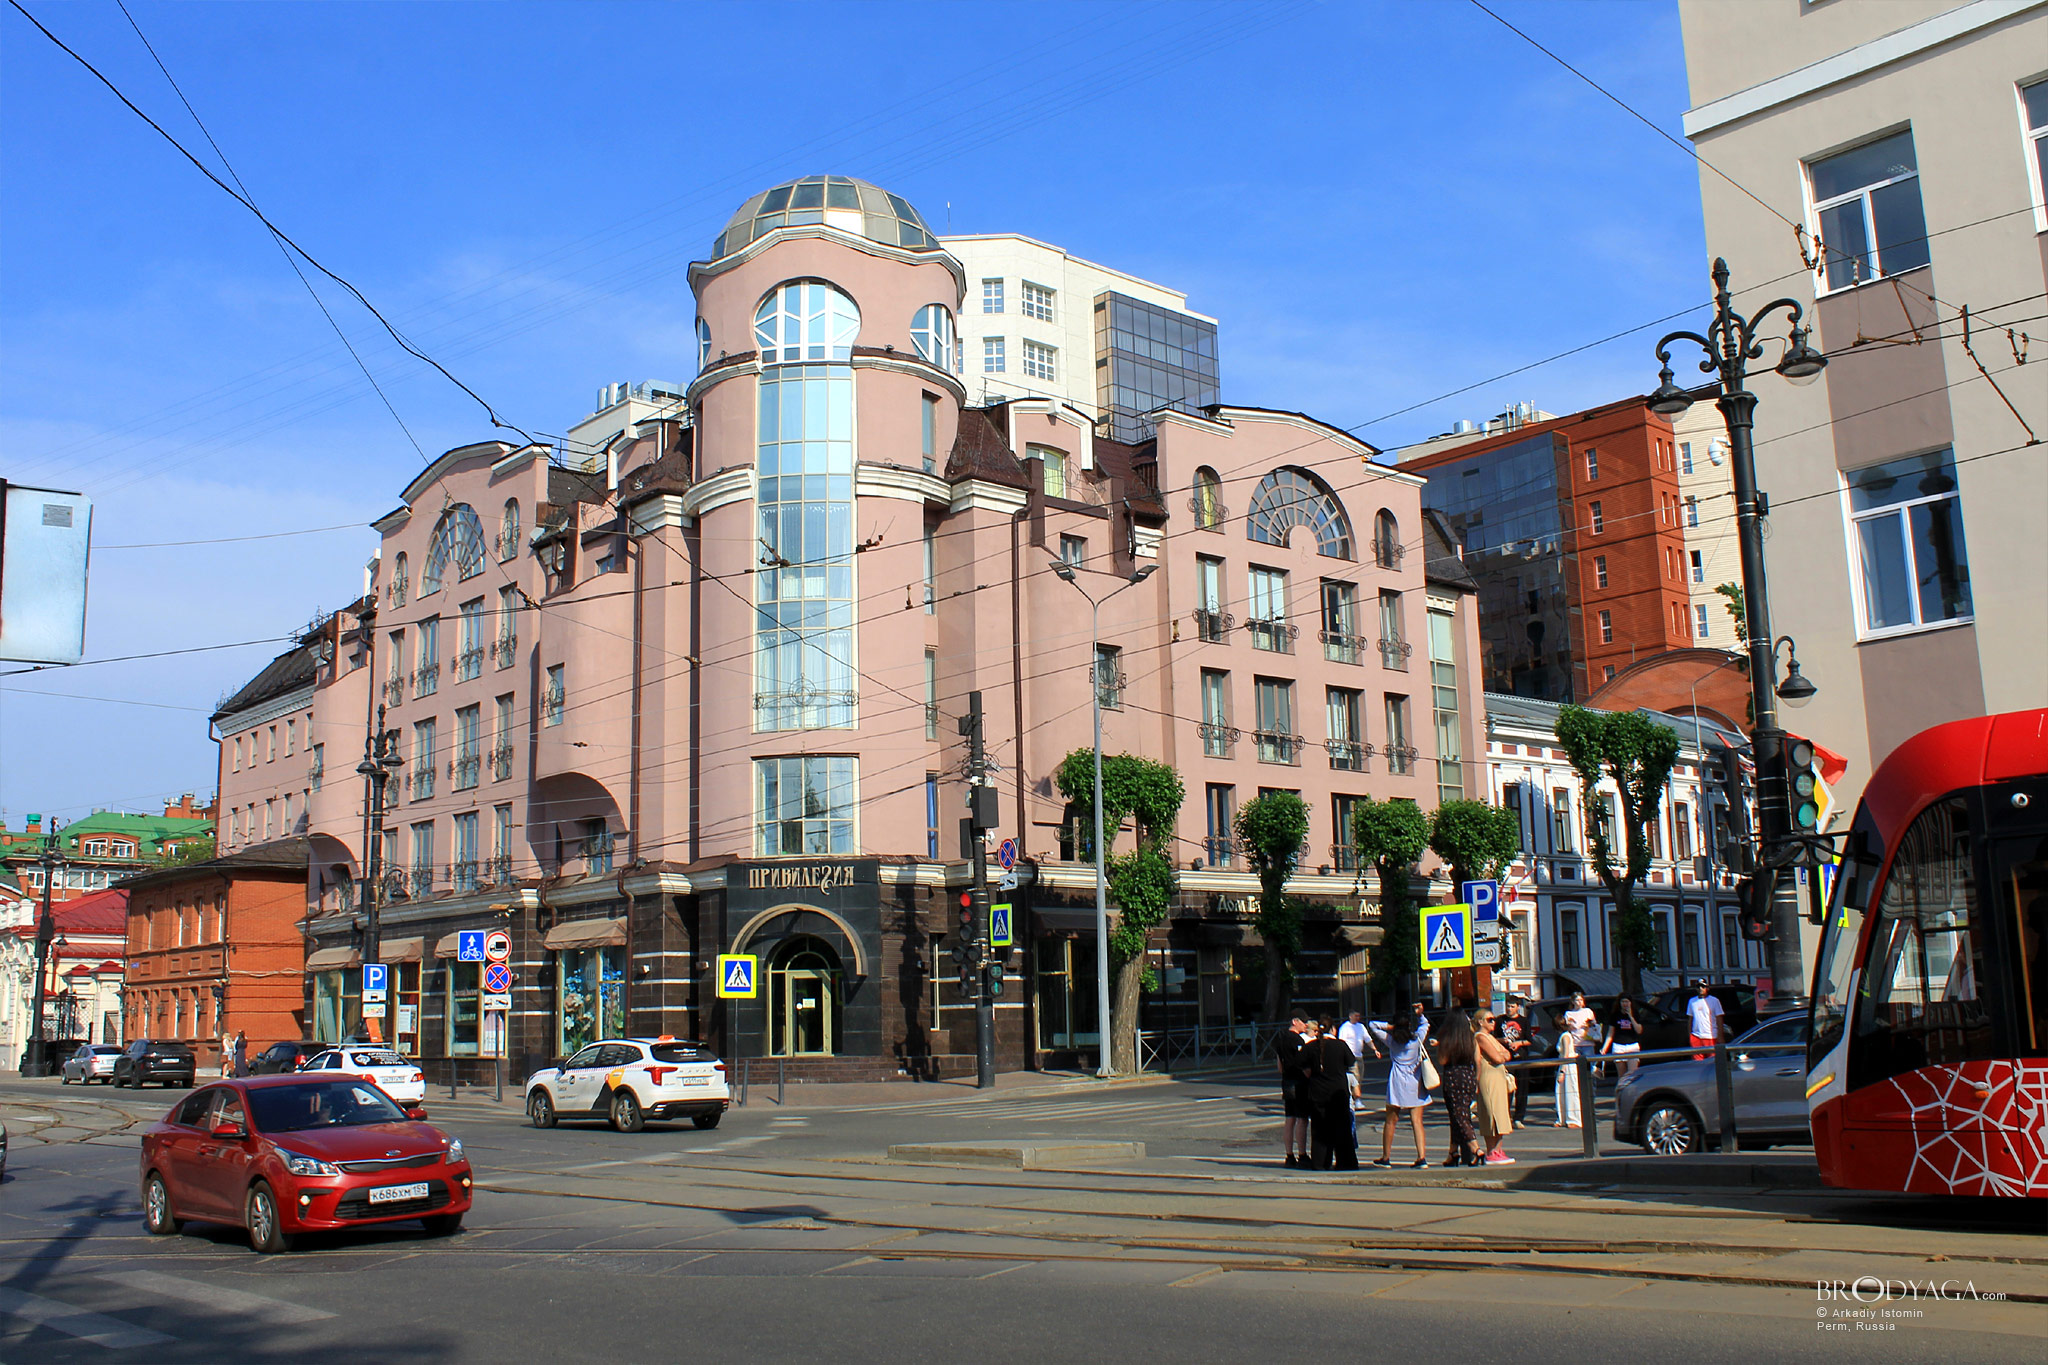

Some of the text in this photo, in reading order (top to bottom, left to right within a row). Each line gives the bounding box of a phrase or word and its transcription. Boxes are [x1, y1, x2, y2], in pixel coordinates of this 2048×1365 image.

[749, 865, 855, 895] ПРИВИЛЕГИЯ
[1472, 884, 1493, 919] P
[1485, 949, 1494, 958] 20
[369, 967, 383, 988] P
